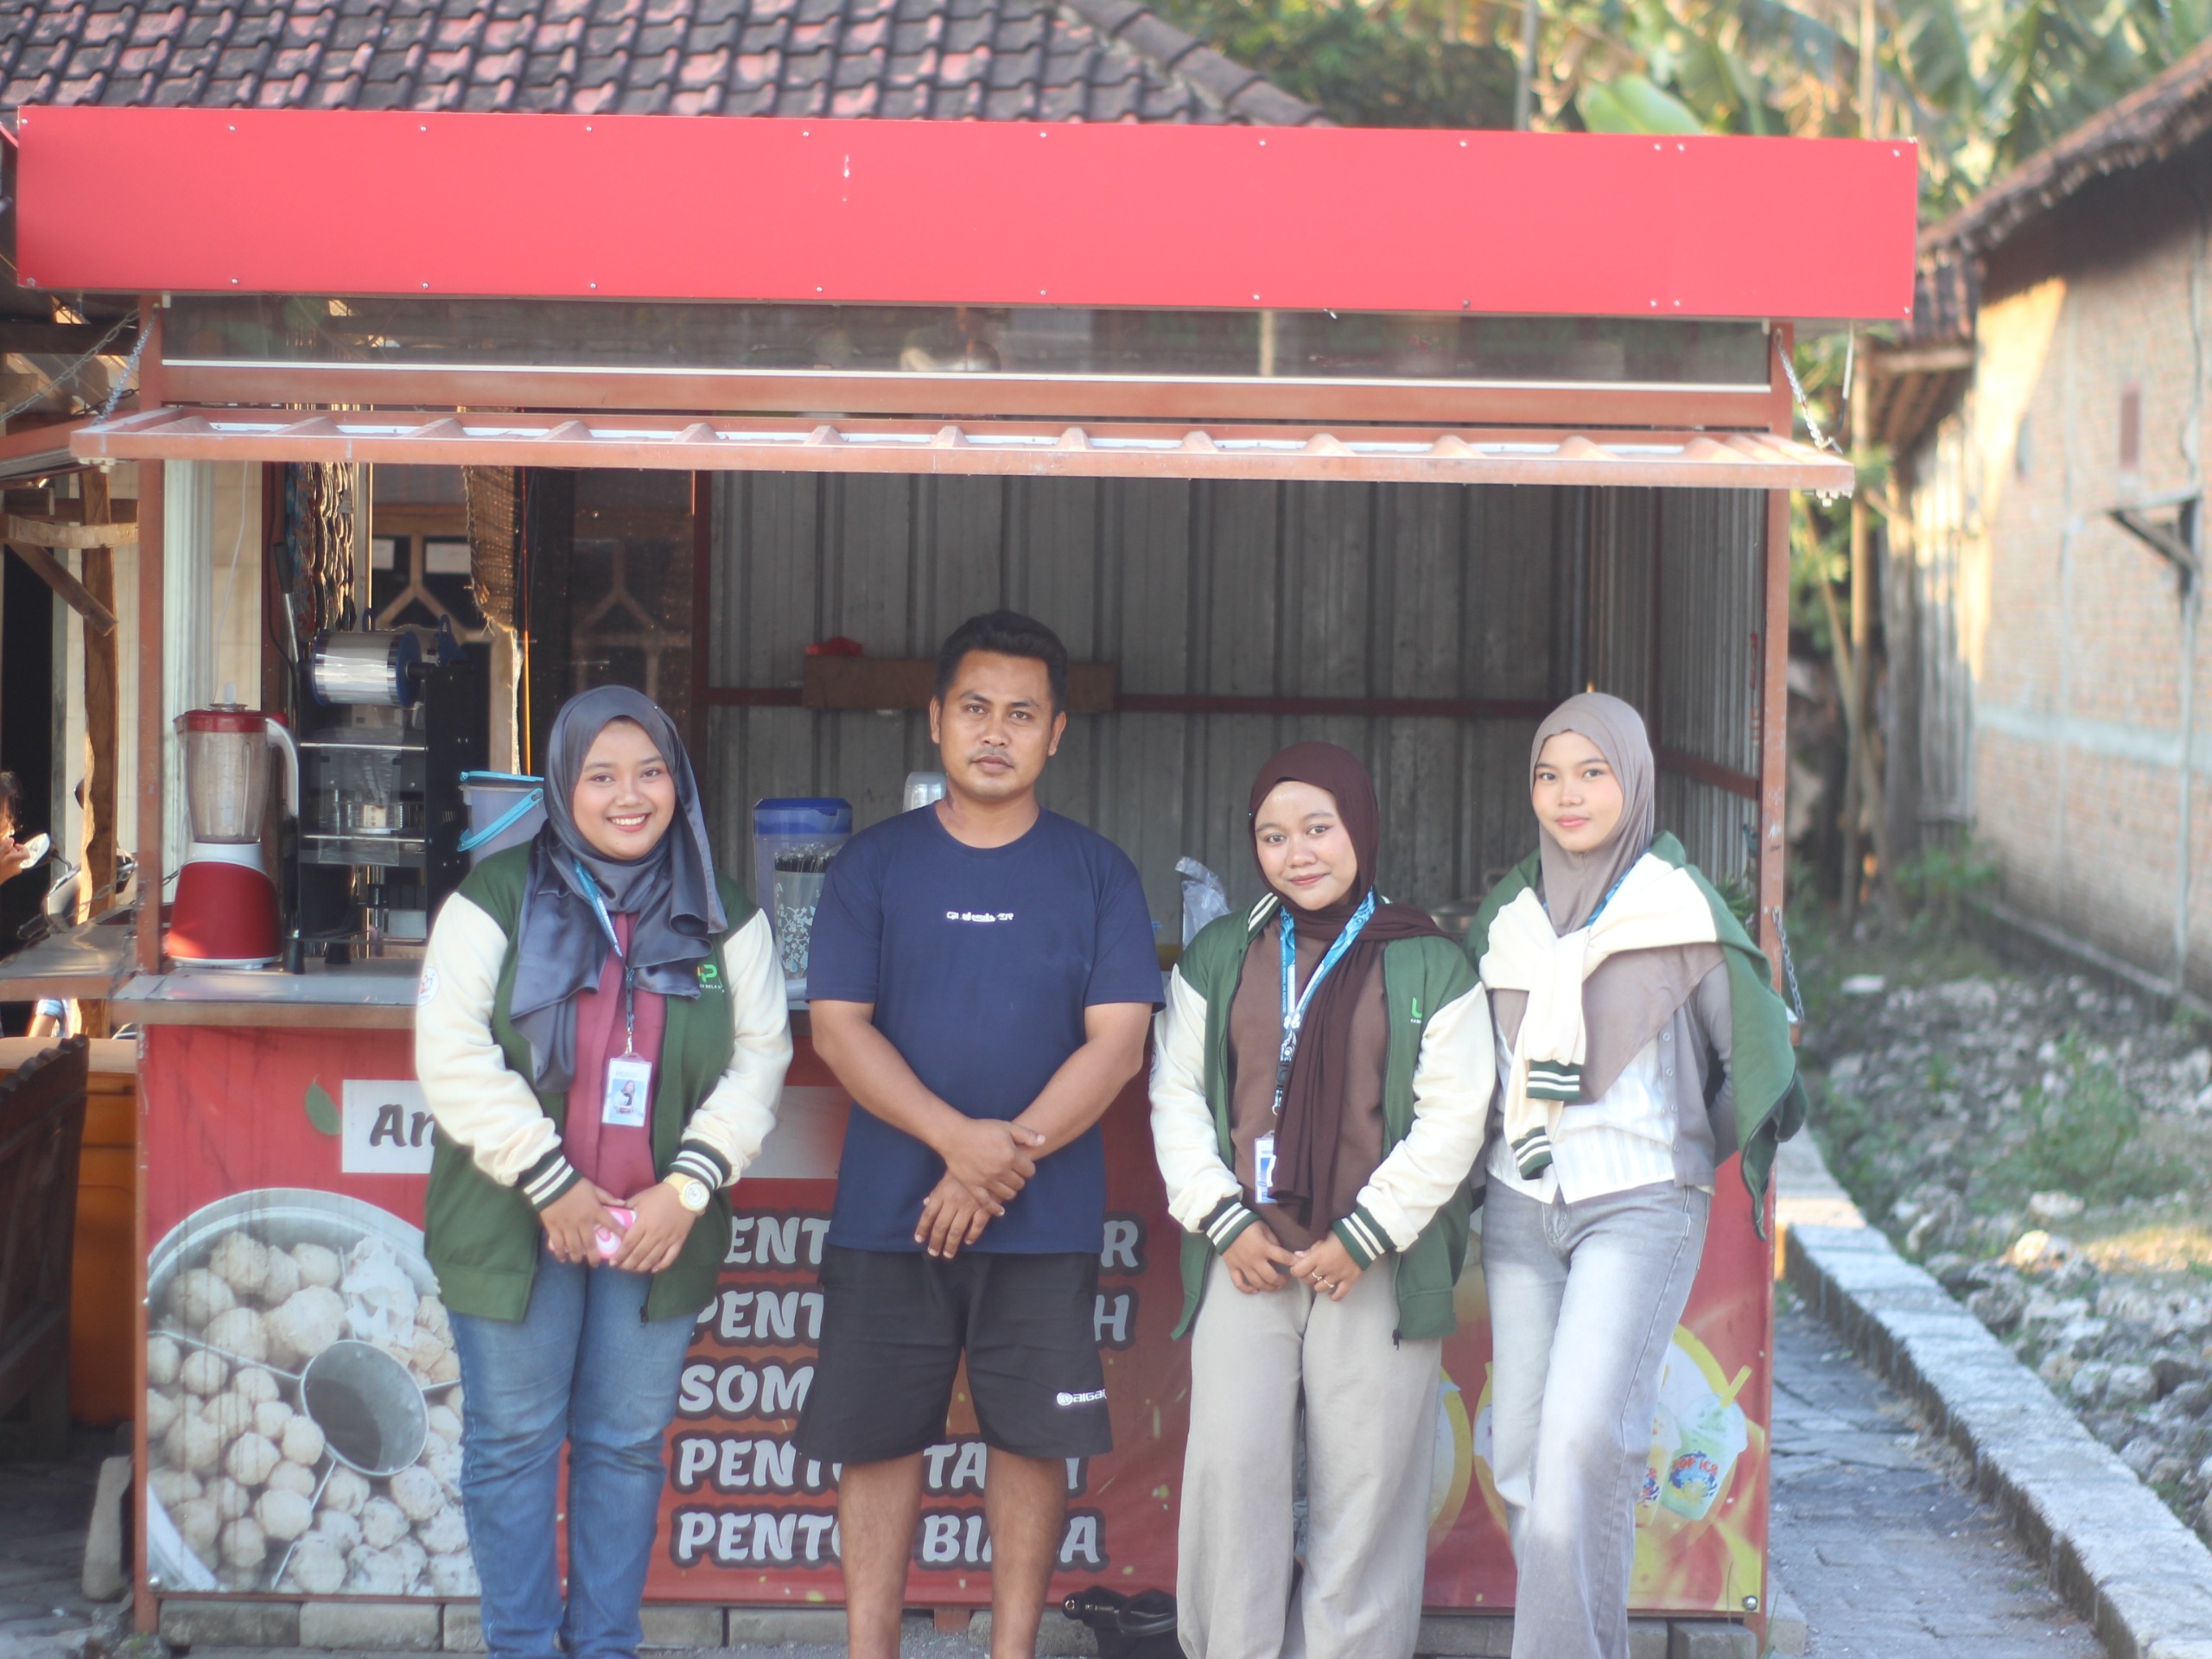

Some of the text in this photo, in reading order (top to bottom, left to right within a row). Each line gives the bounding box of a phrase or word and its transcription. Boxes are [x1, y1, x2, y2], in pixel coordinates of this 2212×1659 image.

[369, 1103, 435, 1147] An
[724, 1216, 832, 1265] ENT
[692, 1291, 824, 1339] ENT
[679, 1364, 815, 1413] SOM
[922, 1515, 1101, 1564] BIA
